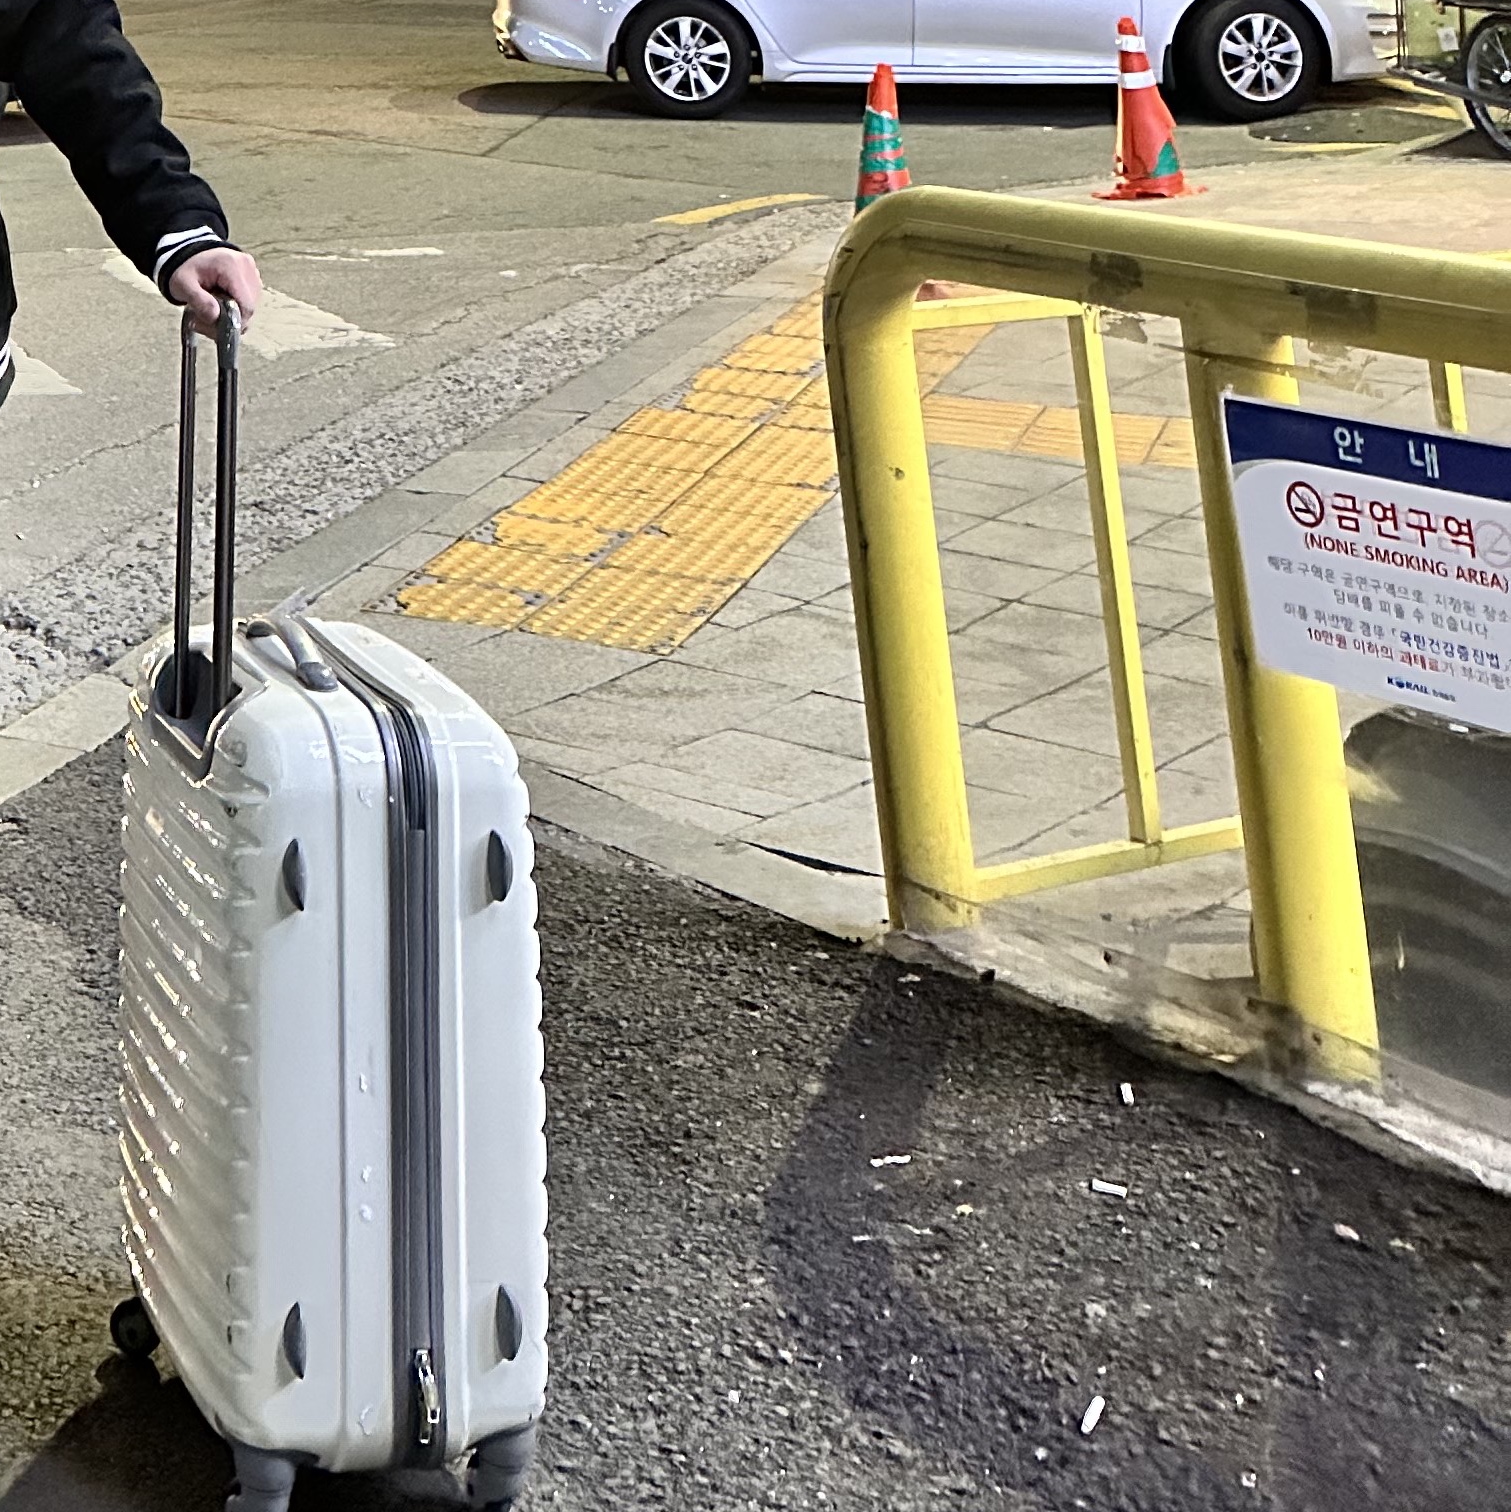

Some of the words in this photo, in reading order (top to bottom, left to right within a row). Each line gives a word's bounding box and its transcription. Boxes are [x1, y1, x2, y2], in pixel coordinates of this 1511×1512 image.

[1333, 426, 1365, 465] 안
[1408, 439, 1439, 479] 내
[1331, 492, 1476, 559] 금연구역
[1297, 561, 1336, 584] 구역은
[1303, 532, 1359, 558] (NONE
[1364, 544, 1449, 578] SMOKING
[1455, 565, 1510, 594] AREA)
[1413, 607, 1425, 625] 수
[1306, 627, 1348, 650] 10만원
[1353, 638, 1395, 662] 이하의
